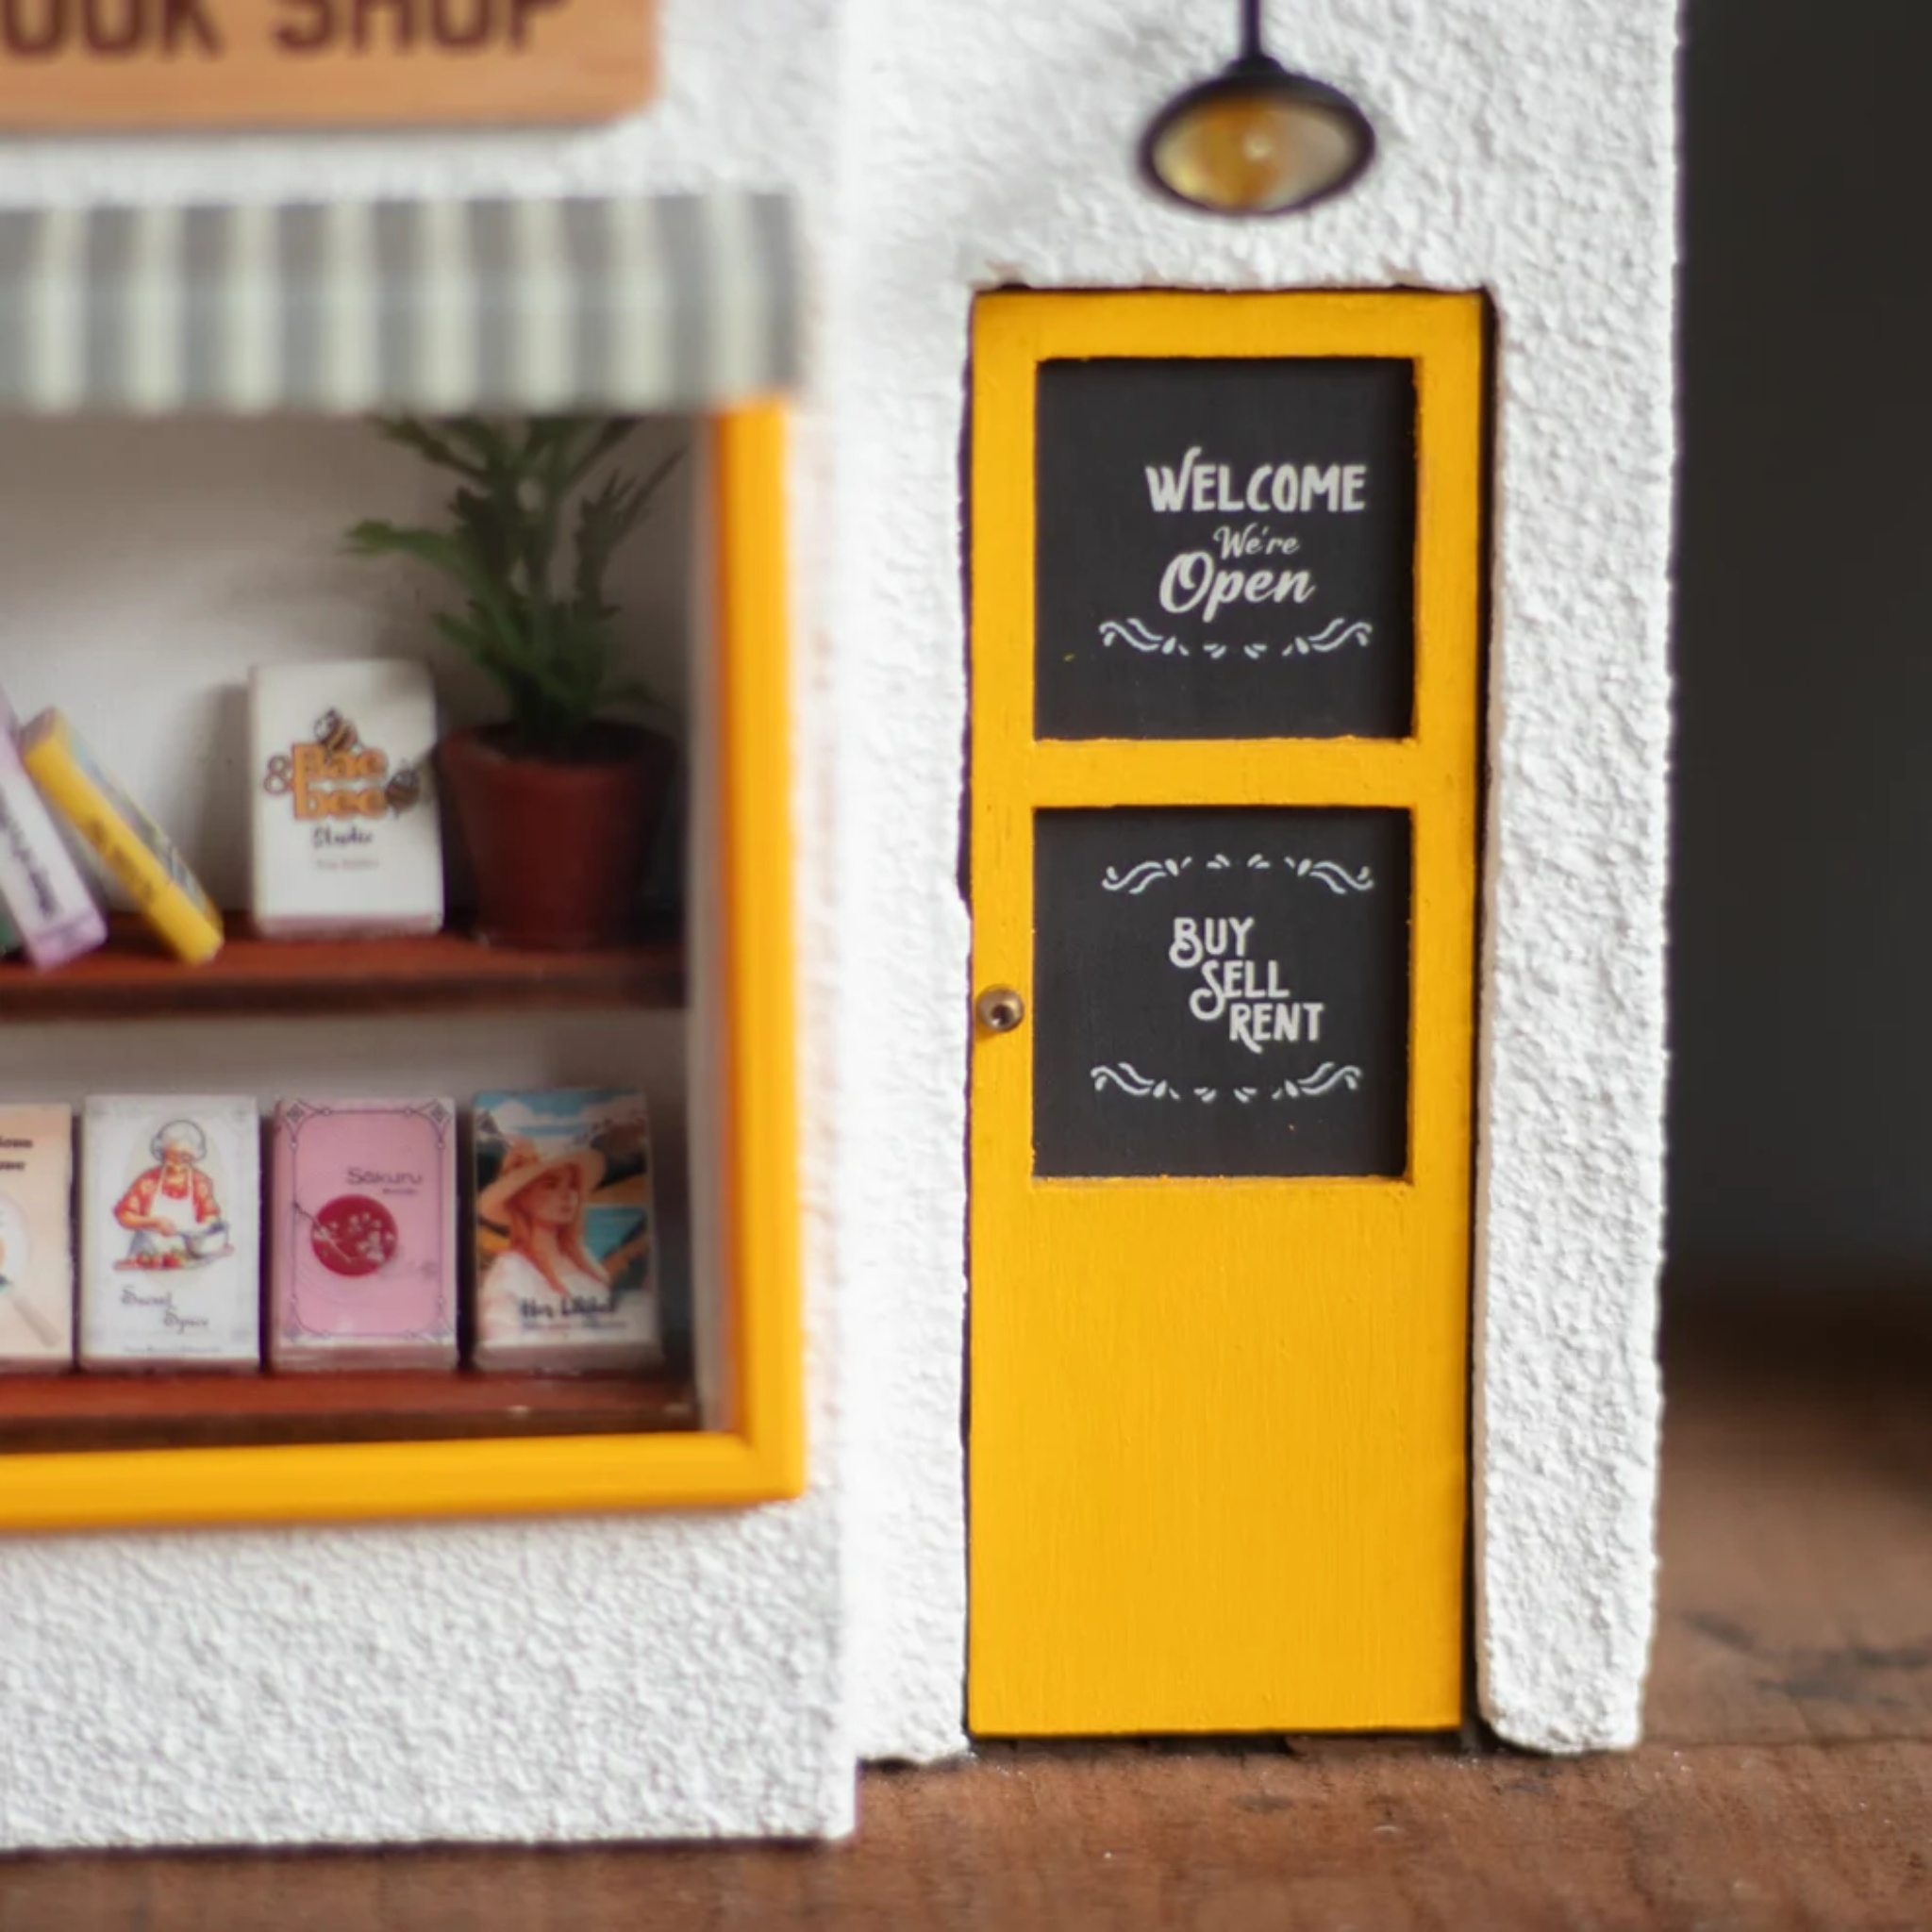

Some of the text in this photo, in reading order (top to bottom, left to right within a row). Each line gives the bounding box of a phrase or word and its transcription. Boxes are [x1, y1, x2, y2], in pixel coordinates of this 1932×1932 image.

[1144, 445, 1367, 512] WELCOME
[1213, 522, 1300, 559] We're
[1158, 551, 1316, 624] Open
[1169, 916, 1255, 968] BUY
[1189, 959, 1291, 1021] SELL
[1228, 1003, 1325, 1054] RENT
